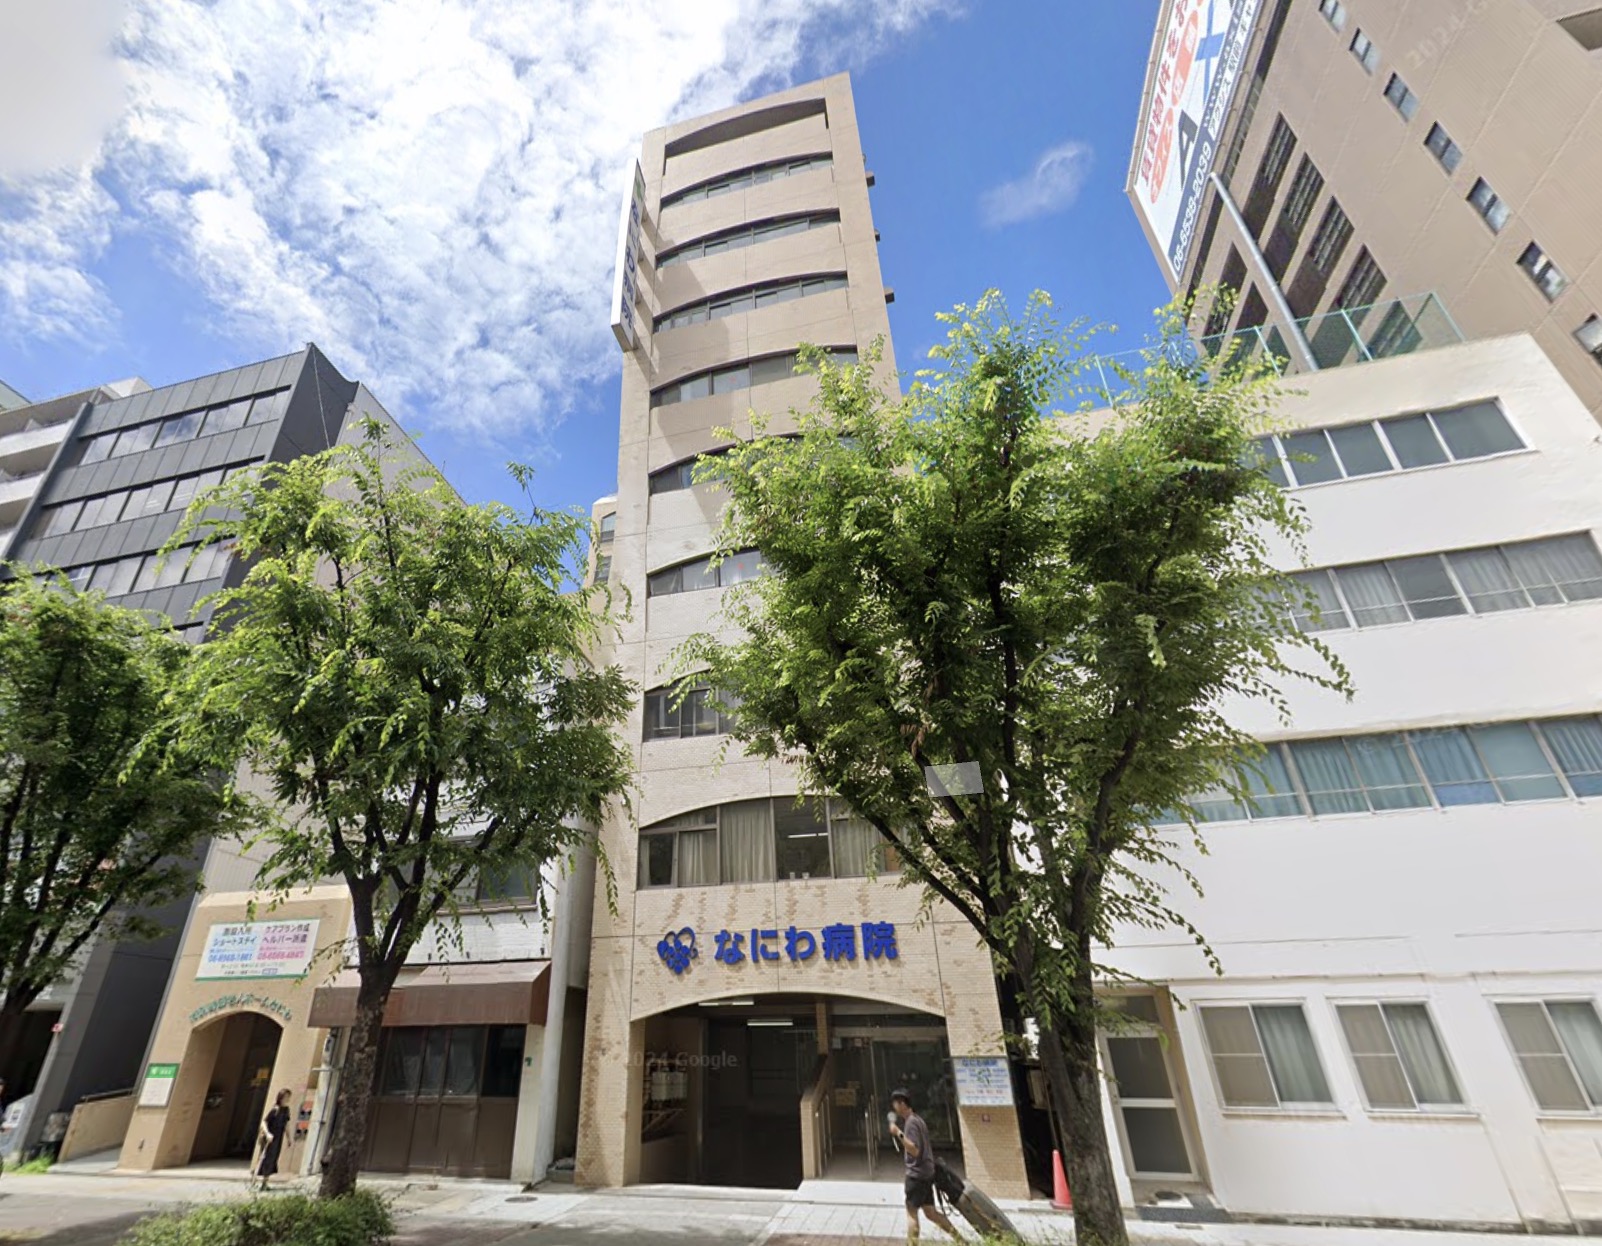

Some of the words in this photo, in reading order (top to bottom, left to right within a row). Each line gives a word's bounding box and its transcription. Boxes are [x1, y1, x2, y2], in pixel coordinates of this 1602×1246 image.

[713, 920, 899, 965] なにわ病院
